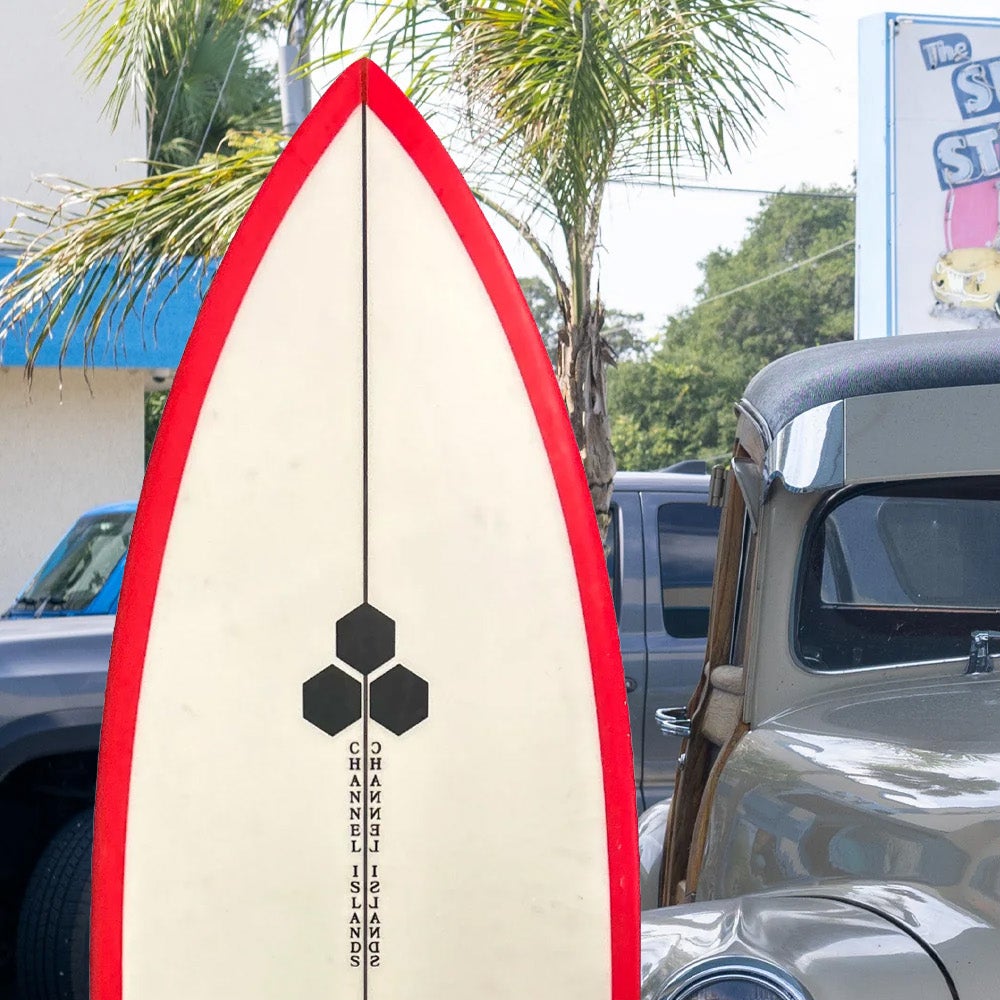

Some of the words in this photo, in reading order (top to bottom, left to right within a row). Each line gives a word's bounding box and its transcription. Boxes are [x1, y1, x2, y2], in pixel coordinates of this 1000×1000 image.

[925, 41, 969, 67] The
[350, 742, 361, 853] CHANNEL
[350, 866, 361, 967] ISLANDS
